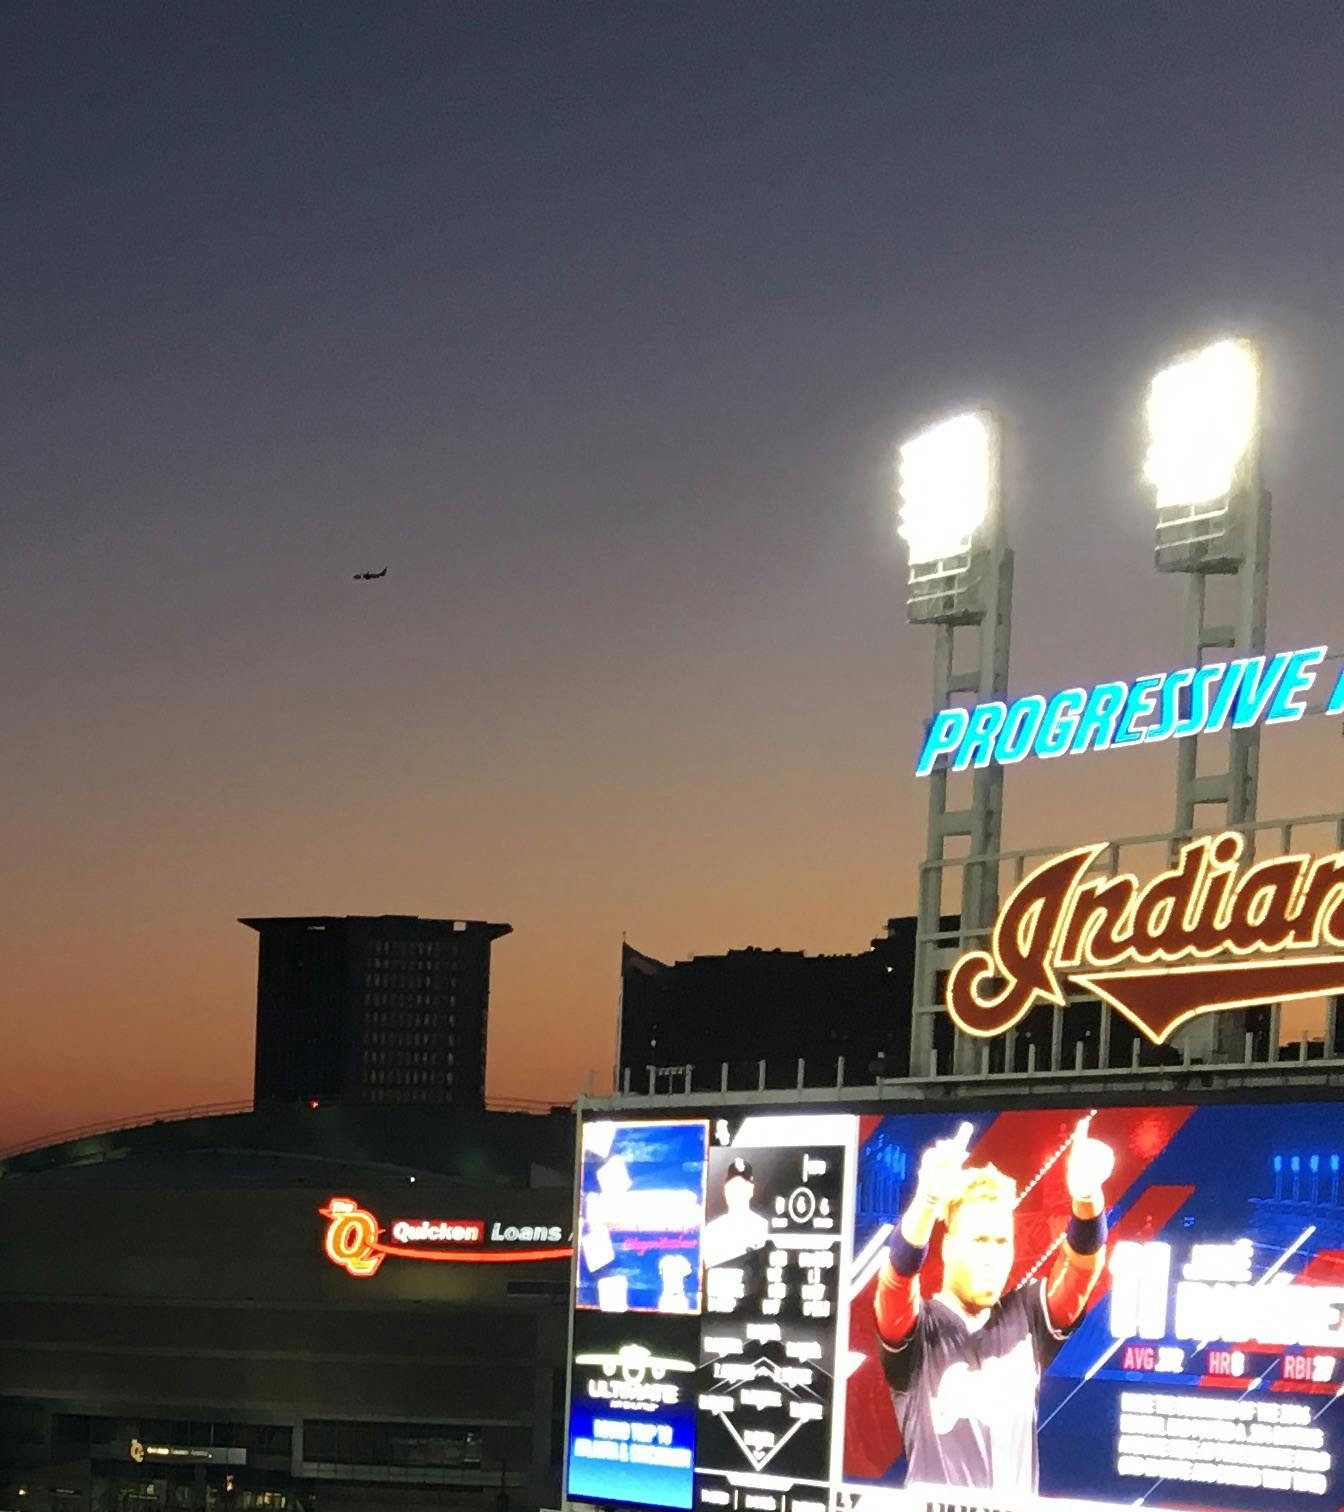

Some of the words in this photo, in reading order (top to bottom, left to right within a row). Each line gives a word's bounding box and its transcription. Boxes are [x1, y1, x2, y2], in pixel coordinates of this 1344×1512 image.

[915, 646, 1328, 776] PROGRESSIVE
[393, 1222, 479, 1241] Quicken
[491, 1223, 561, 1242] Loans
[1123, 1347, 1154, 1369] AVG
[1209, 1351, 1231, 1374] HR
[1284, 1355, 1311, 1379] RBI
